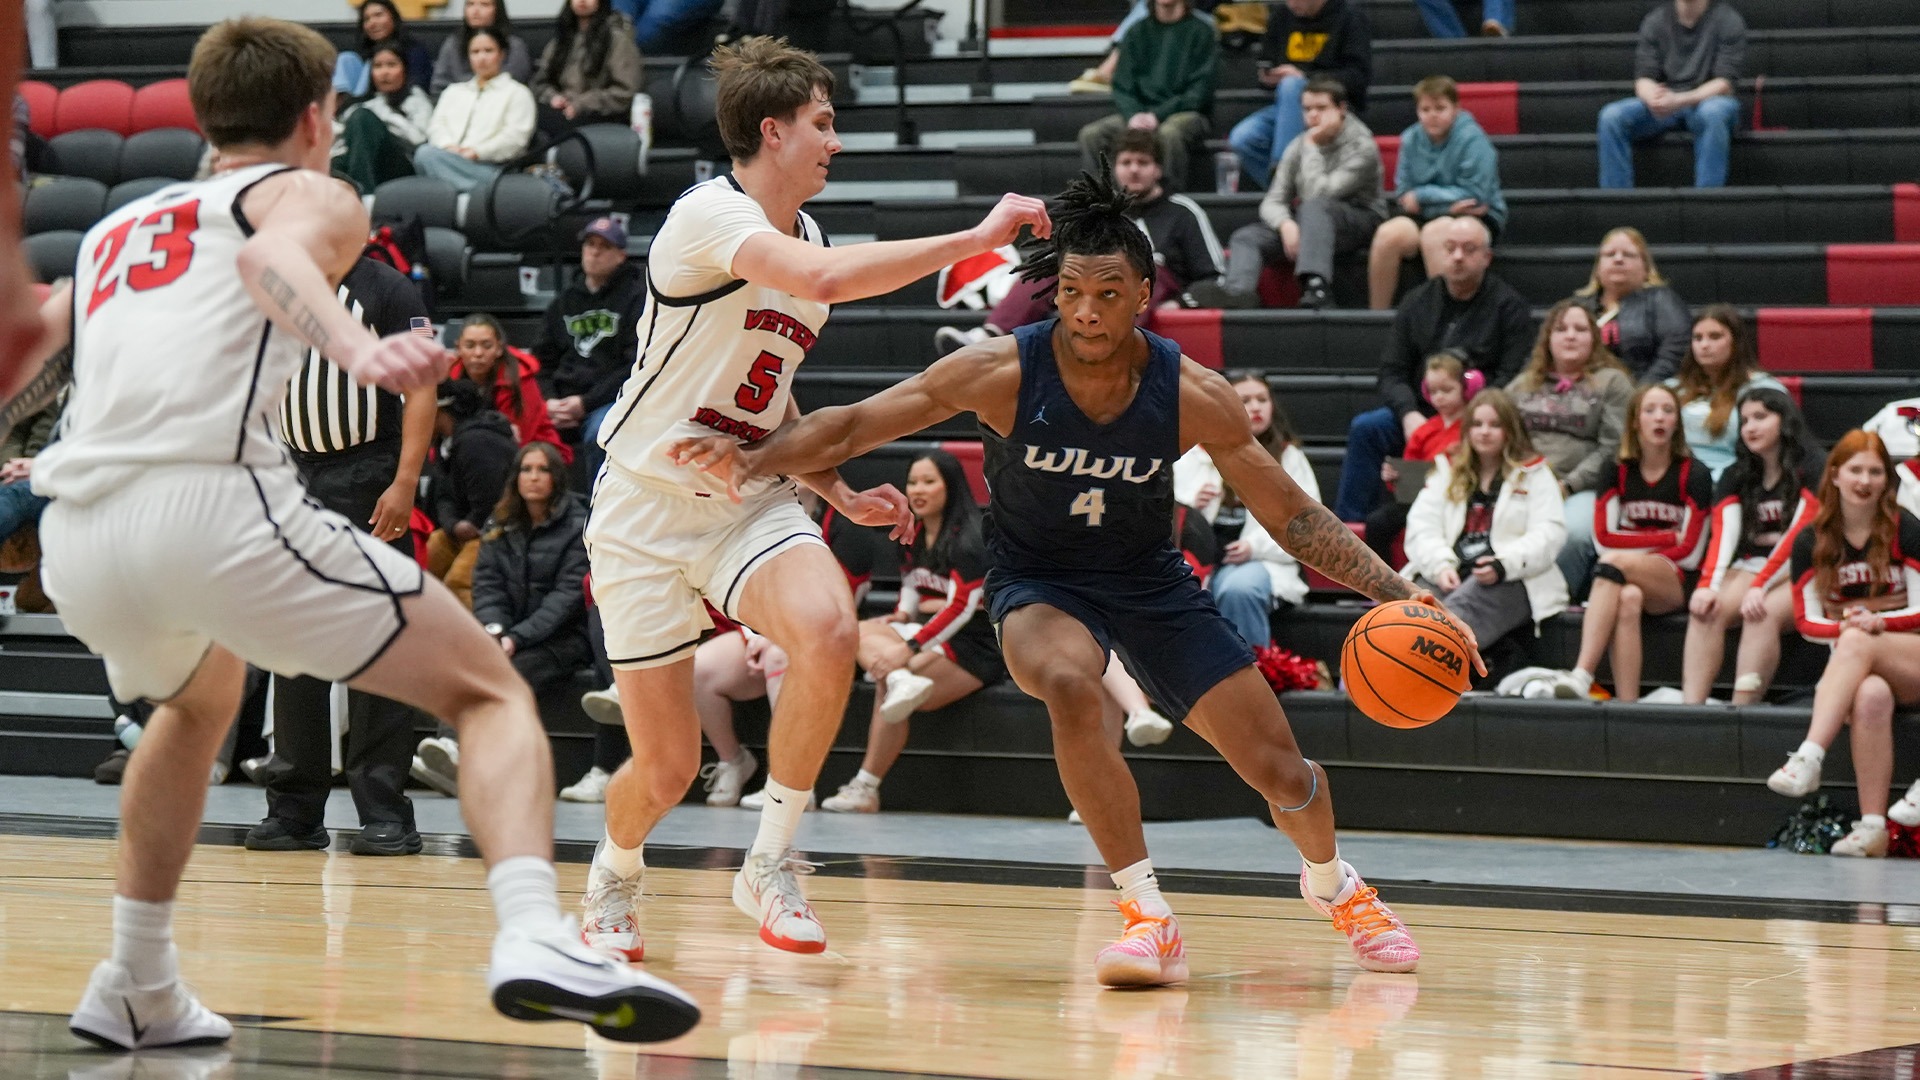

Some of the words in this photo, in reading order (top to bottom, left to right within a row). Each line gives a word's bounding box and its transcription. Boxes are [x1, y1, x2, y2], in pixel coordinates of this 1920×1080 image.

[87, 198, 201, 319] 23
[744, 308, 817, 353] WSTER
[734, 349, 784, 415] 5
[1024, 443, 1163, 484] WWU
[1069, 486, 1106, 527] 4
[1410, 635, 1463, 676] NCAA
